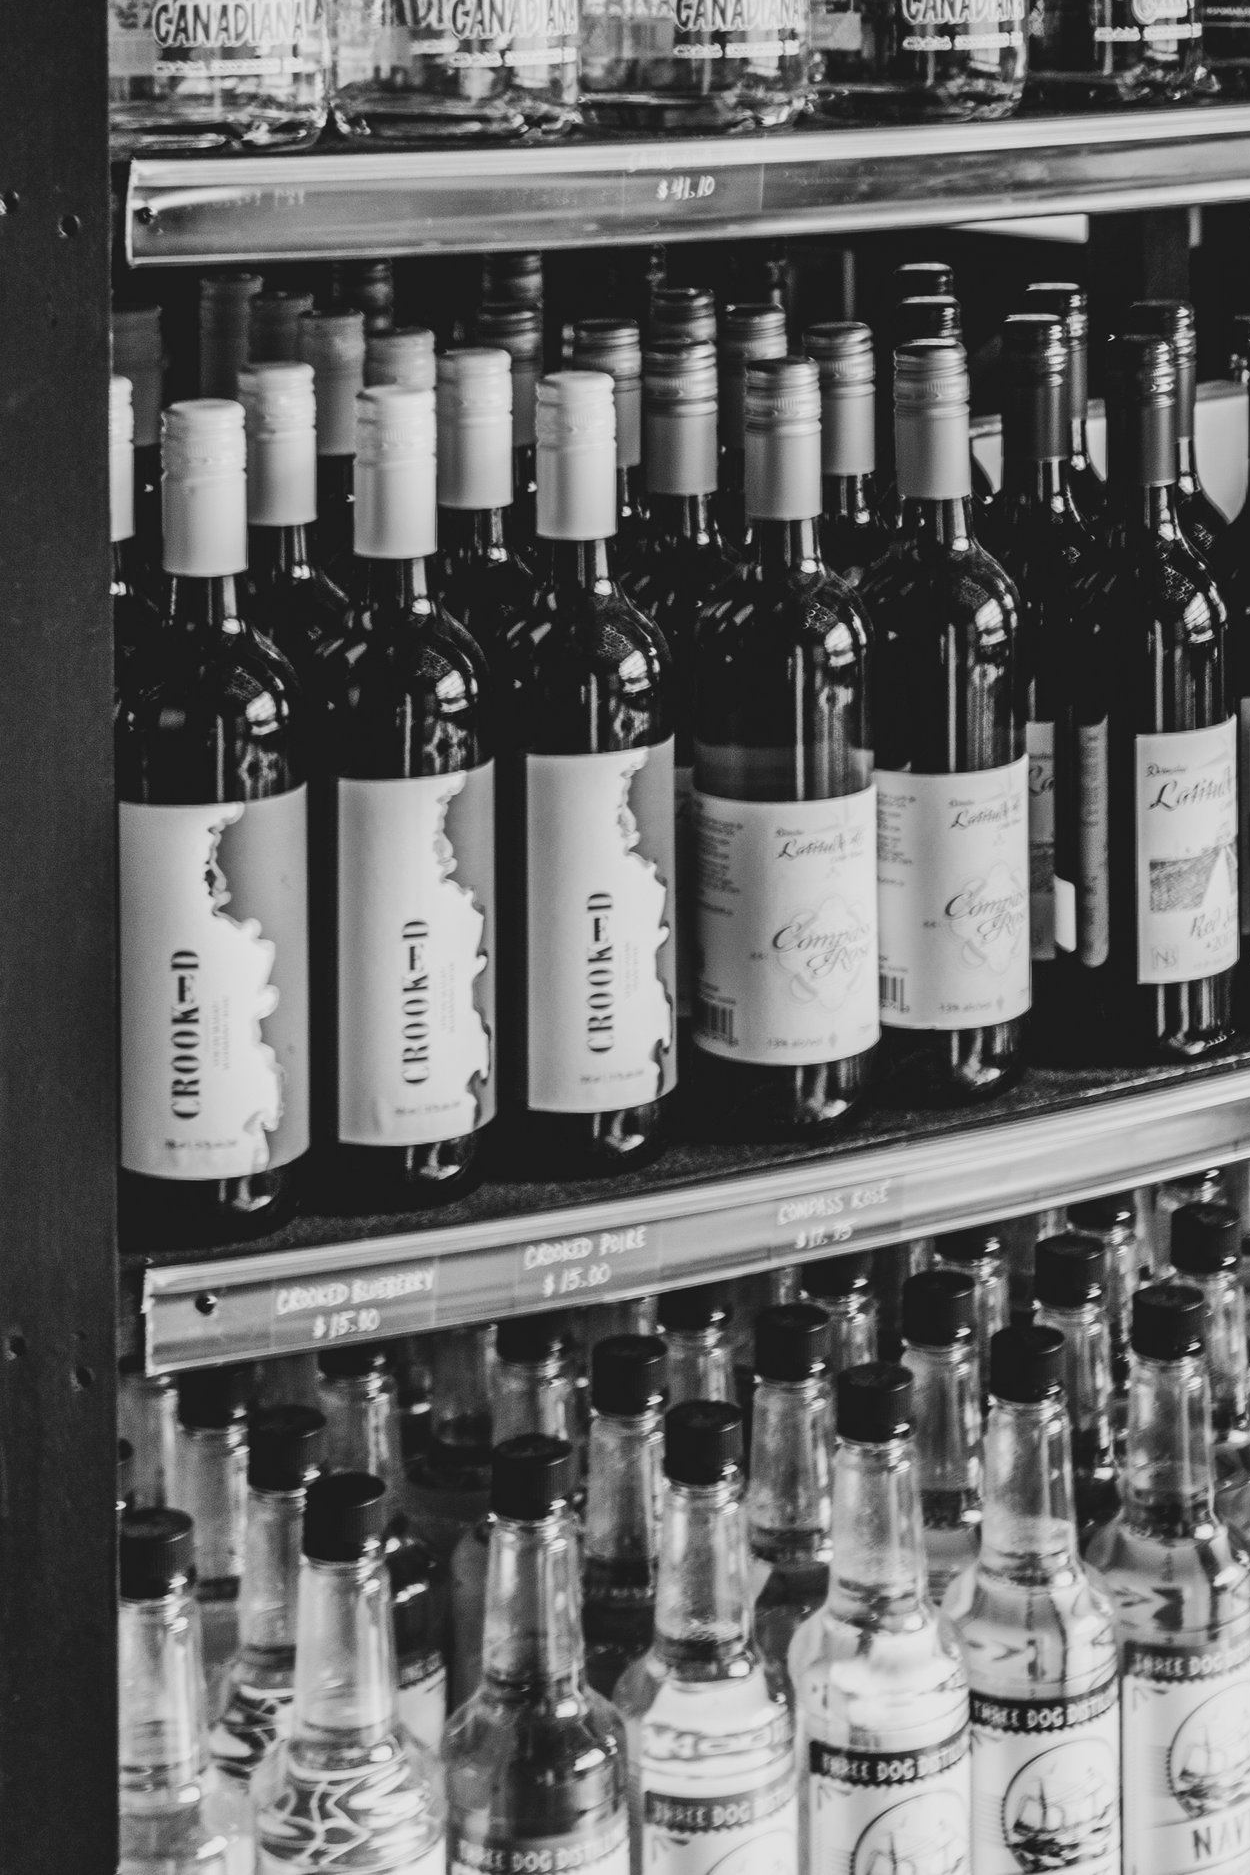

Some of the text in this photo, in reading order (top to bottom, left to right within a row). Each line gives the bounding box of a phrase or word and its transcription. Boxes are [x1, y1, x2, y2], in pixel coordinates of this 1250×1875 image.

[657, 175, 716, 201] $41.10
[777, 1192, 844, 1225] COMPASS
[523, 1225, 649, 1271] CROOKED POIRE
[276, 1282, 350, 1316] CROOKED
[1027, 1706, 1065, 1727] DOG
[876, 1757, 917, 1782] DOG
[712, 1800, 752, 1827] DOG
[512, 1847, 552, 1873] DOG
